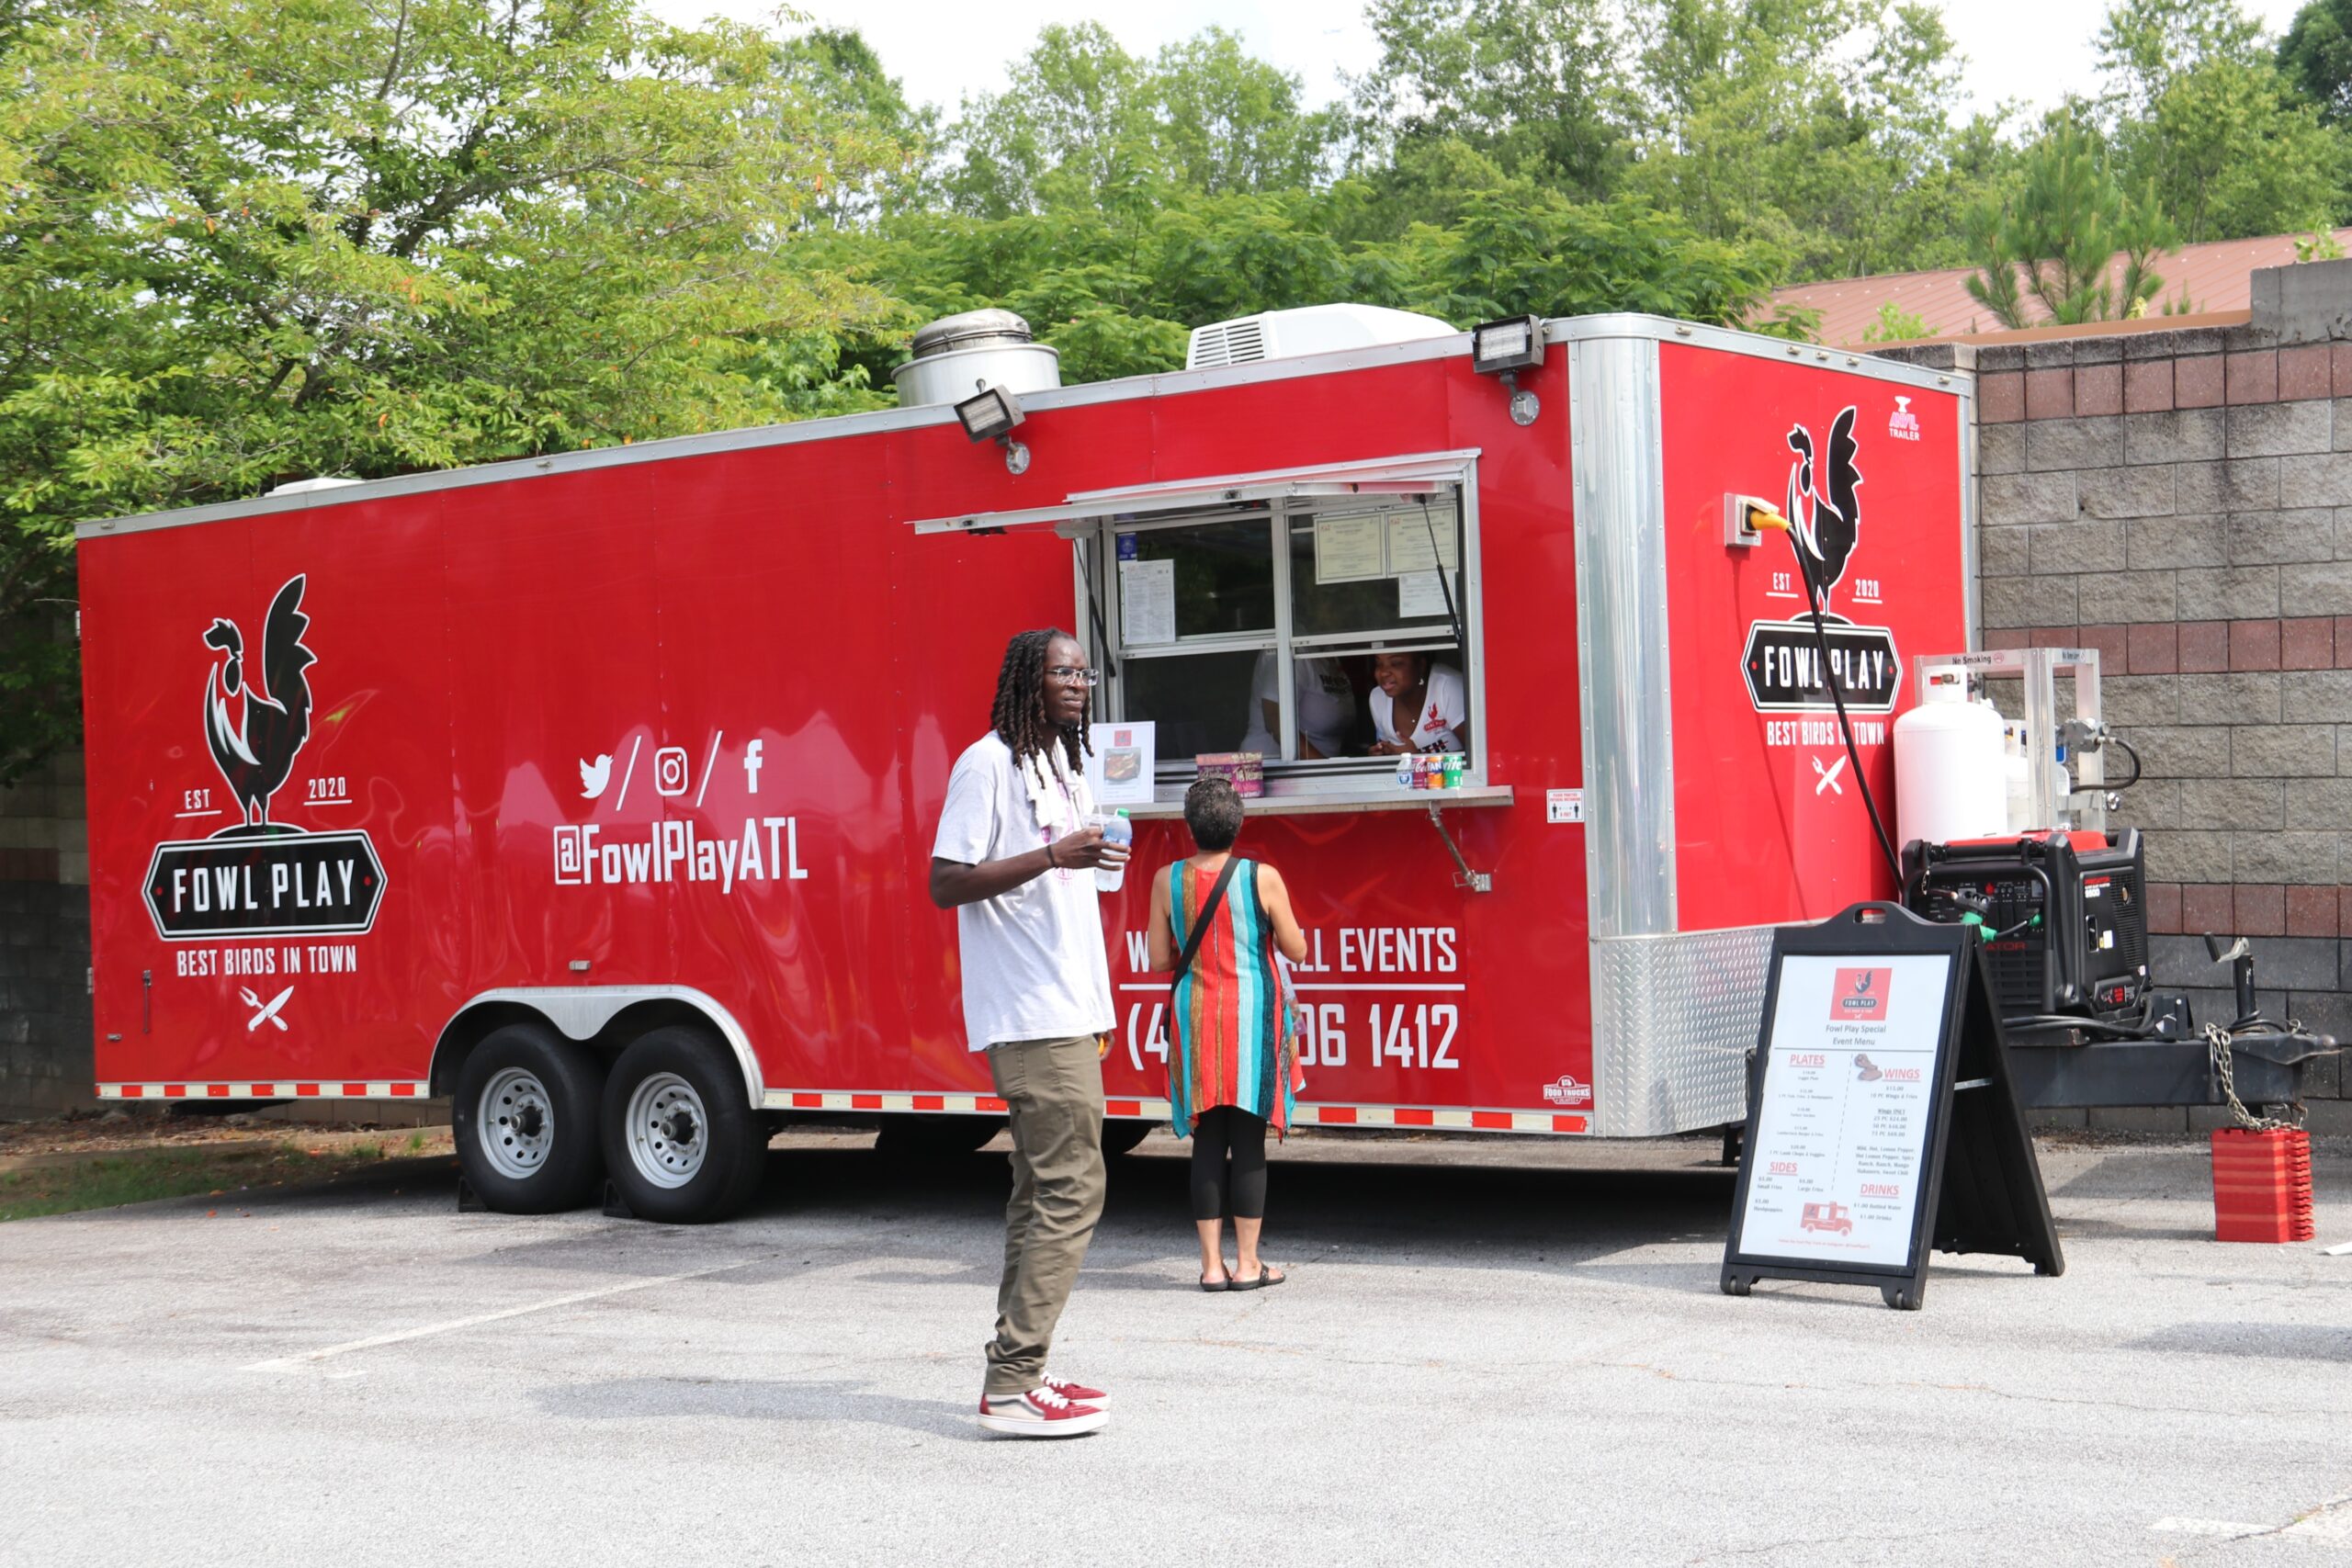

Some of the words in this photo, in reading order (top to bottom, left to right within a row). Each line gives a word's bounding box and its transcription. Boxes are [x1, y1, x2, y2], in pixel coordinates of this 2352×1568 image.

[1889, 427, 1920, 441] TRAILER
[1772, 572, 1791, 591] EST
[1855, 579, 1880, 598] 2020
[1764, 645, 1823, 688] FOWL
[1830, 649, 1883, 690] PLAY
[1962, 655, 1992, 665] Smoking
[1767, 721, 1797, 746] BEST
[1801, 721, 1835, 746] BIRDS
[1853, 722, 1884, 746] TOWN
[309, 776, 346, 799] 2020
[185, 788, 210, 810] EST
[553, 816, 808, 895] @FowlPlayATL
[173, 865, 258, 913] FOWL
[272, 859, 355, 908] PLAY
[1340, 927, 1457, 973] EVENTS
[1985, 940, 2027, 951] ATOR
[176, 948, 218, 977] BEST
[224, 946, 276, 976] BIRDS
[283, 946, 300, 974] IN
[308, 944, 356, 974] TOWN
[1368, 1003, 1459, 1069] 1412
[1826, 1024, 1843, 1032] Fowl
[1845, 1024, 1860, 1034] Play
[1860, 1024, 1886, 1034] Special
[1833, 1037, 1853, 1045] Event
[1854, 1037, 1876, 1045] Menu
[1790, 1054, 1826, 1066] PLATES
[1883, 1068, 1920, 1079] WINGS
[1544, 1088, 1563, 1098] FOOD
[1563, 1088, 1590, 1098] TRUCKS
[1770, 1161, 1798, 1173] SIDES
[1860, 1183, 1900, 1196] DRINKS
